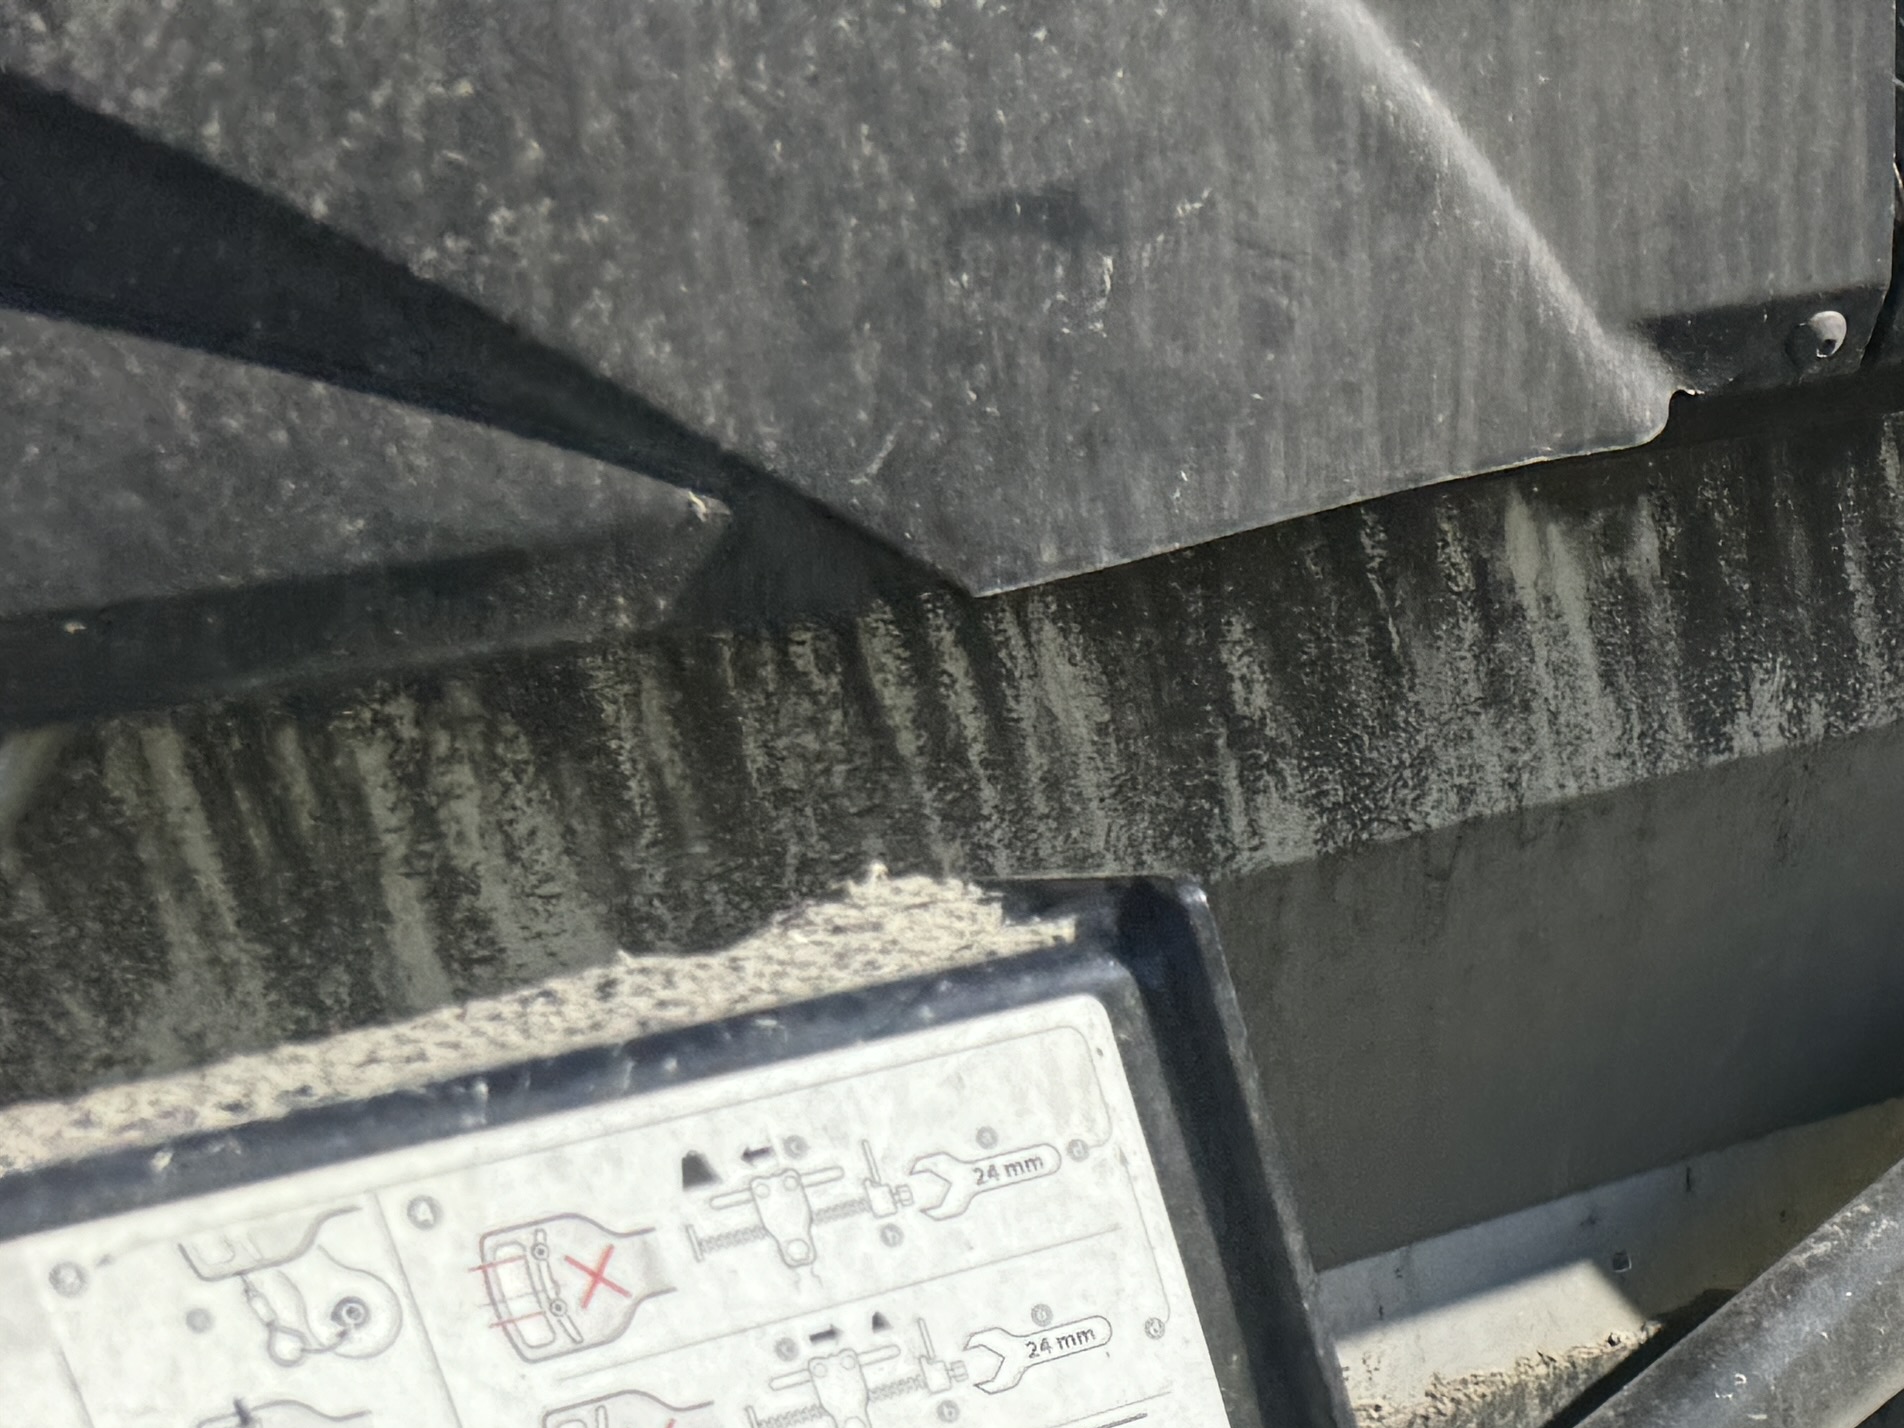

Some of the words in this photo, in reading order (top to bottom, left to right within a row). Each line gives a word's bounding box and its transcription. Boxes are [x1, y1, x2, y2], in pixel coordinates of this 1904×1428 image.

[973, 1164, 1000, 1186] 24
[1003, 1156, 1043, 1177] mm
[1025, 1337, 1053, 1358] 24
[1056, 1328, 1095, 1350] mm
